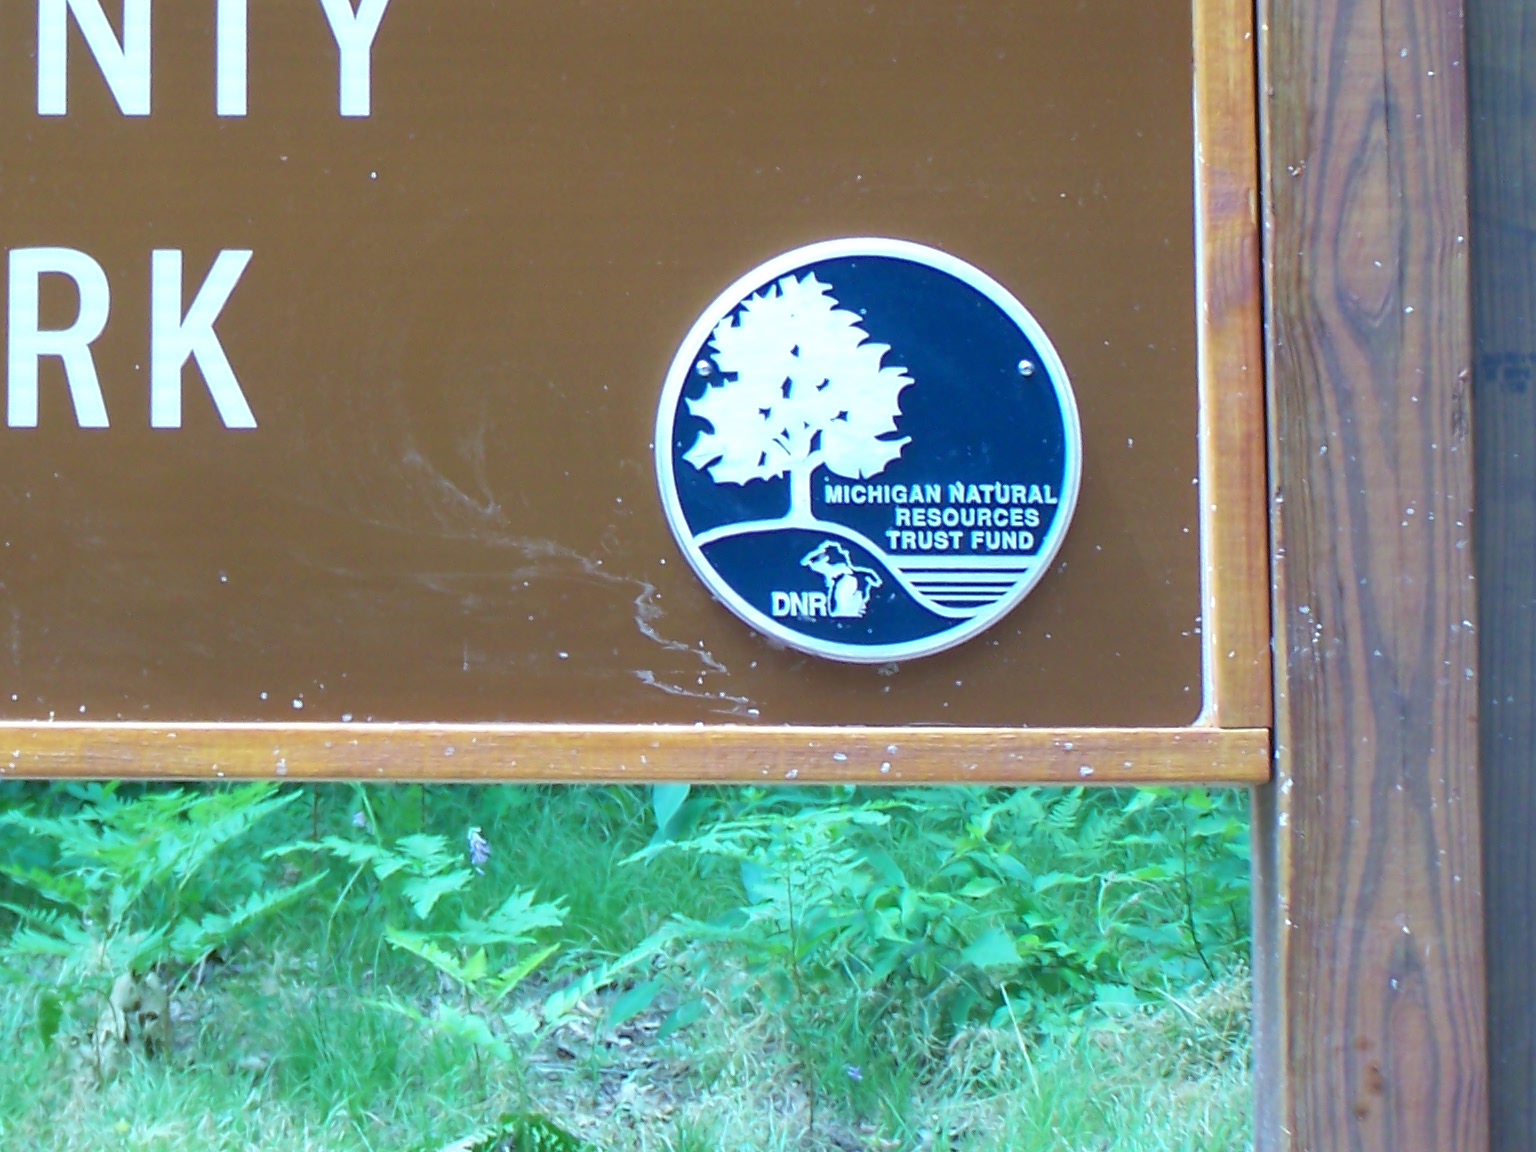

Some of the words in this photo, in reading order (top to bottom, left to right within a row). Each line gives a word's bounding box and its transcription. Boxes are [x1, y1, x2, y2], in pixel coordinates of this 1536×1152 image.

[825, 484, 942, 504] MICHIGAN
[949, 483, 1058, 505] NATURAL
[895, 507, 1041, 528] RESOURCES
[886, 530, 964, 550] TRUST
[971, 530, 1034, 550] FUND
[771, 590, 828, 617] DNR
